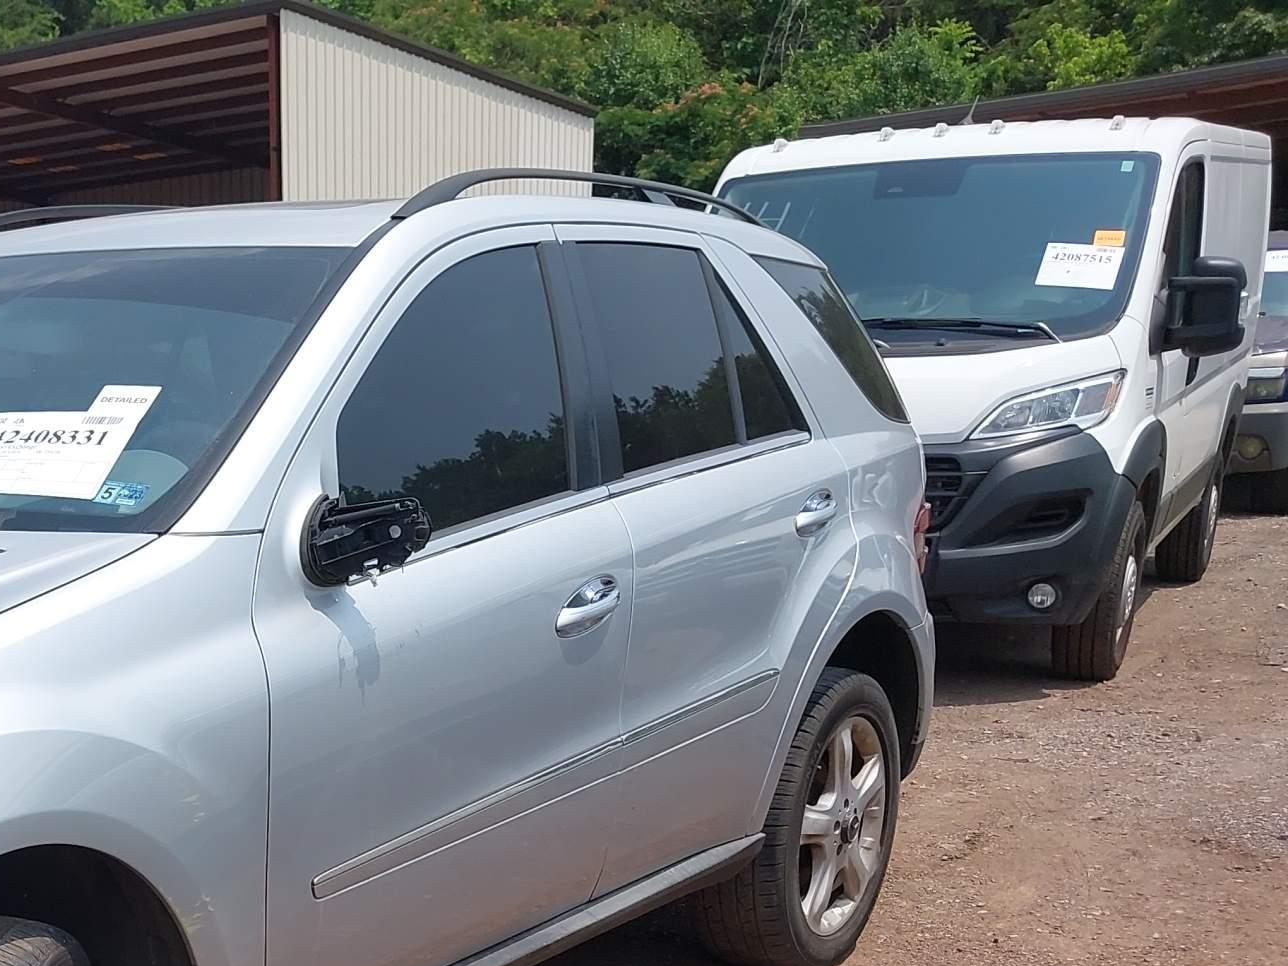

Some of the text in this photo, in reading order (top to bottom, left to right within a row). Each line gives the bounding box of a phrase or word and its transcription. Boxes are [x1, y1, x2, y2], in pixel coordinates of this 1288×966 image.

[1051, 252, 1113, 264] 42087515
[99, 396, 148, 404] DETAILED
[100, 487, 116, 500] 5
